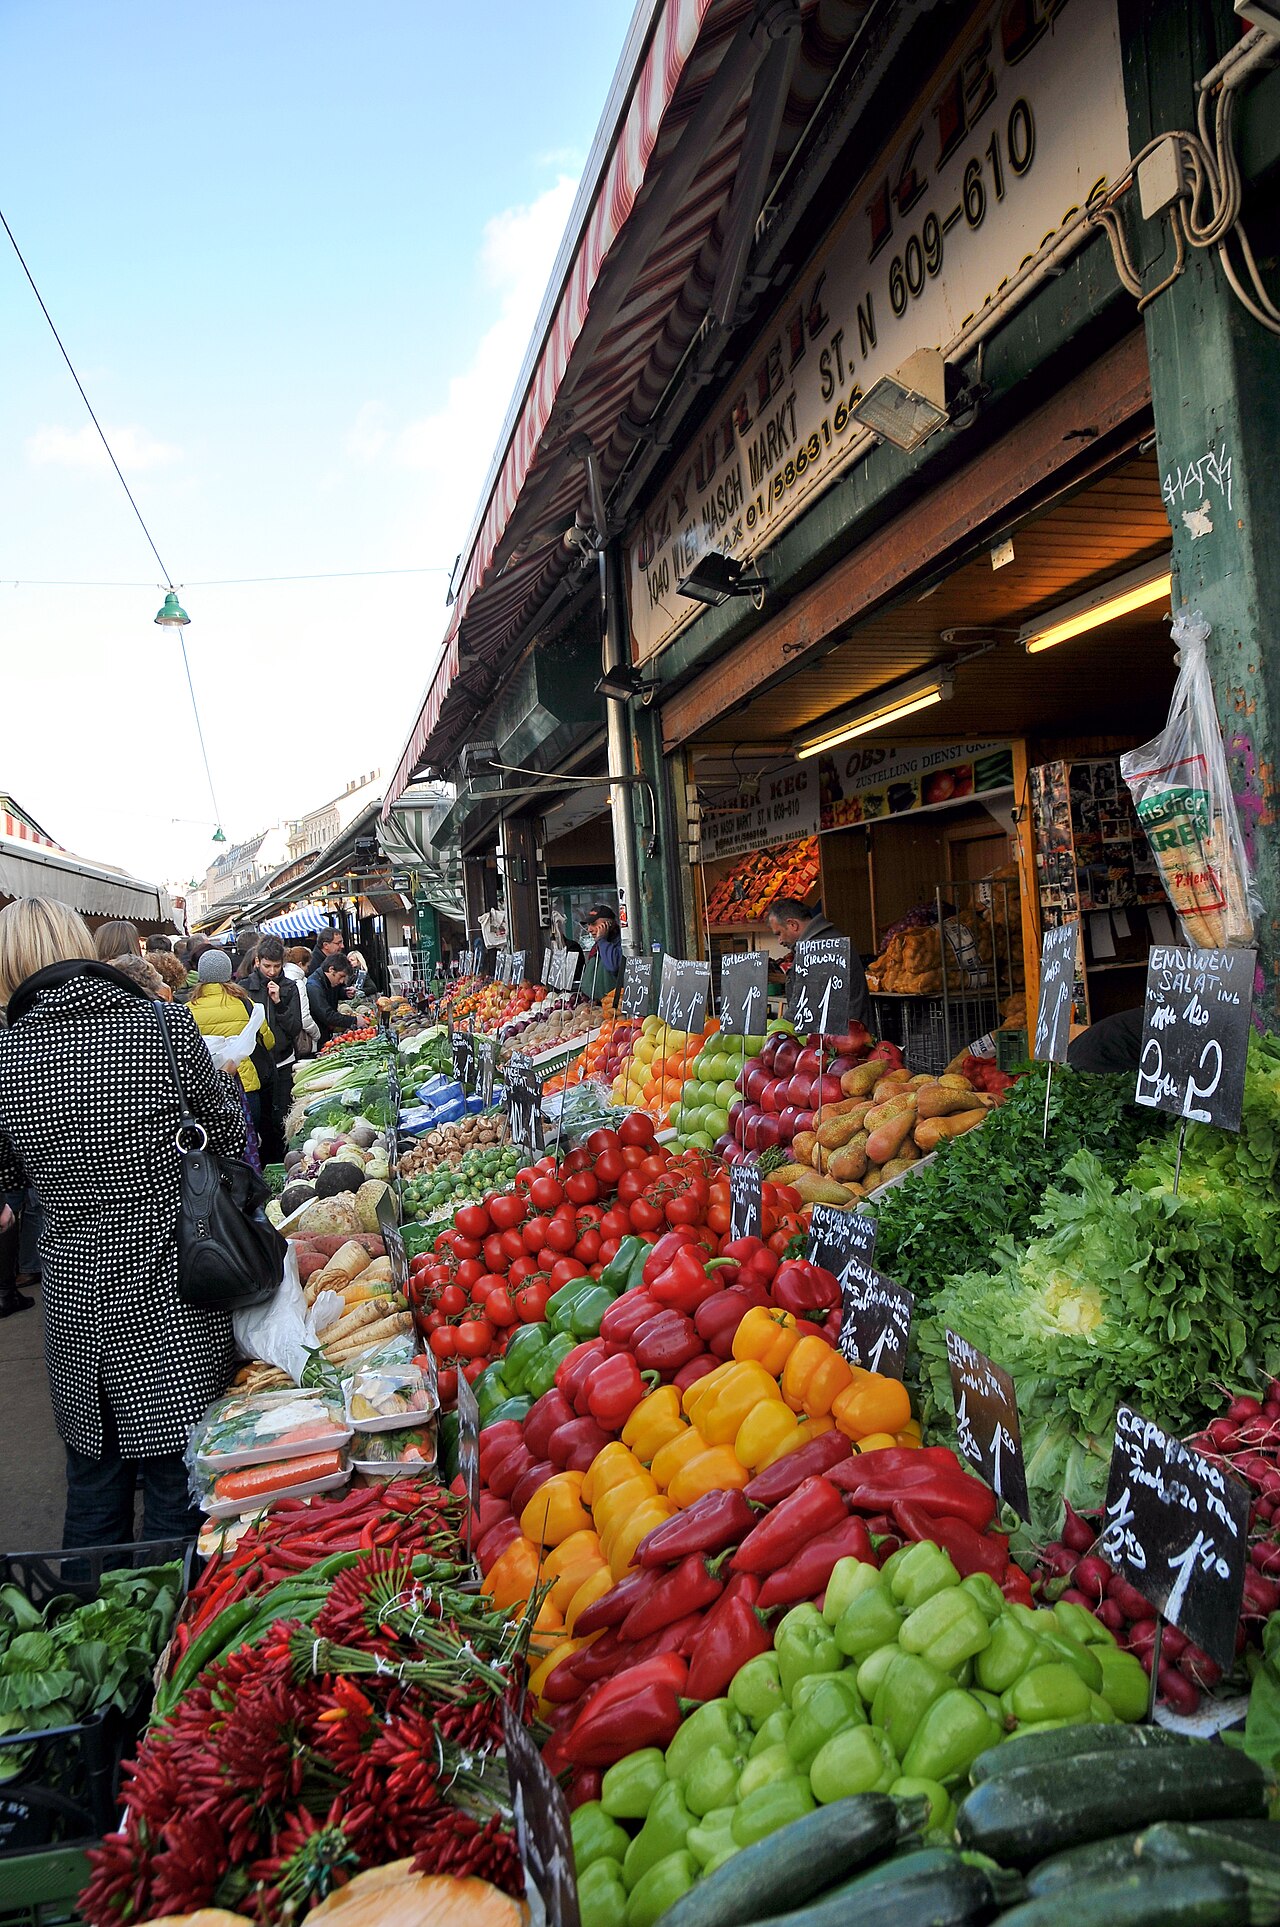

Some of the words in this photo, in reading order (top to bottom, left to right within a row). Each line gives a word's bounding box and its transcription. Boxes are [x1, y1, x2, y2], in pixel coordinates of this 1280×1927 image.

[647, 561, 670, 610] 1040
[702, 462, 744, 546] NASCH
[748, 390, 798, 490] MARKT
[857, 292, 878, 359] N
[888, 96, 1036, 318] 609-610
[855, 760, 918, 789] ZUSTELLUNG
[921, 745, 963, 769] DIENST
